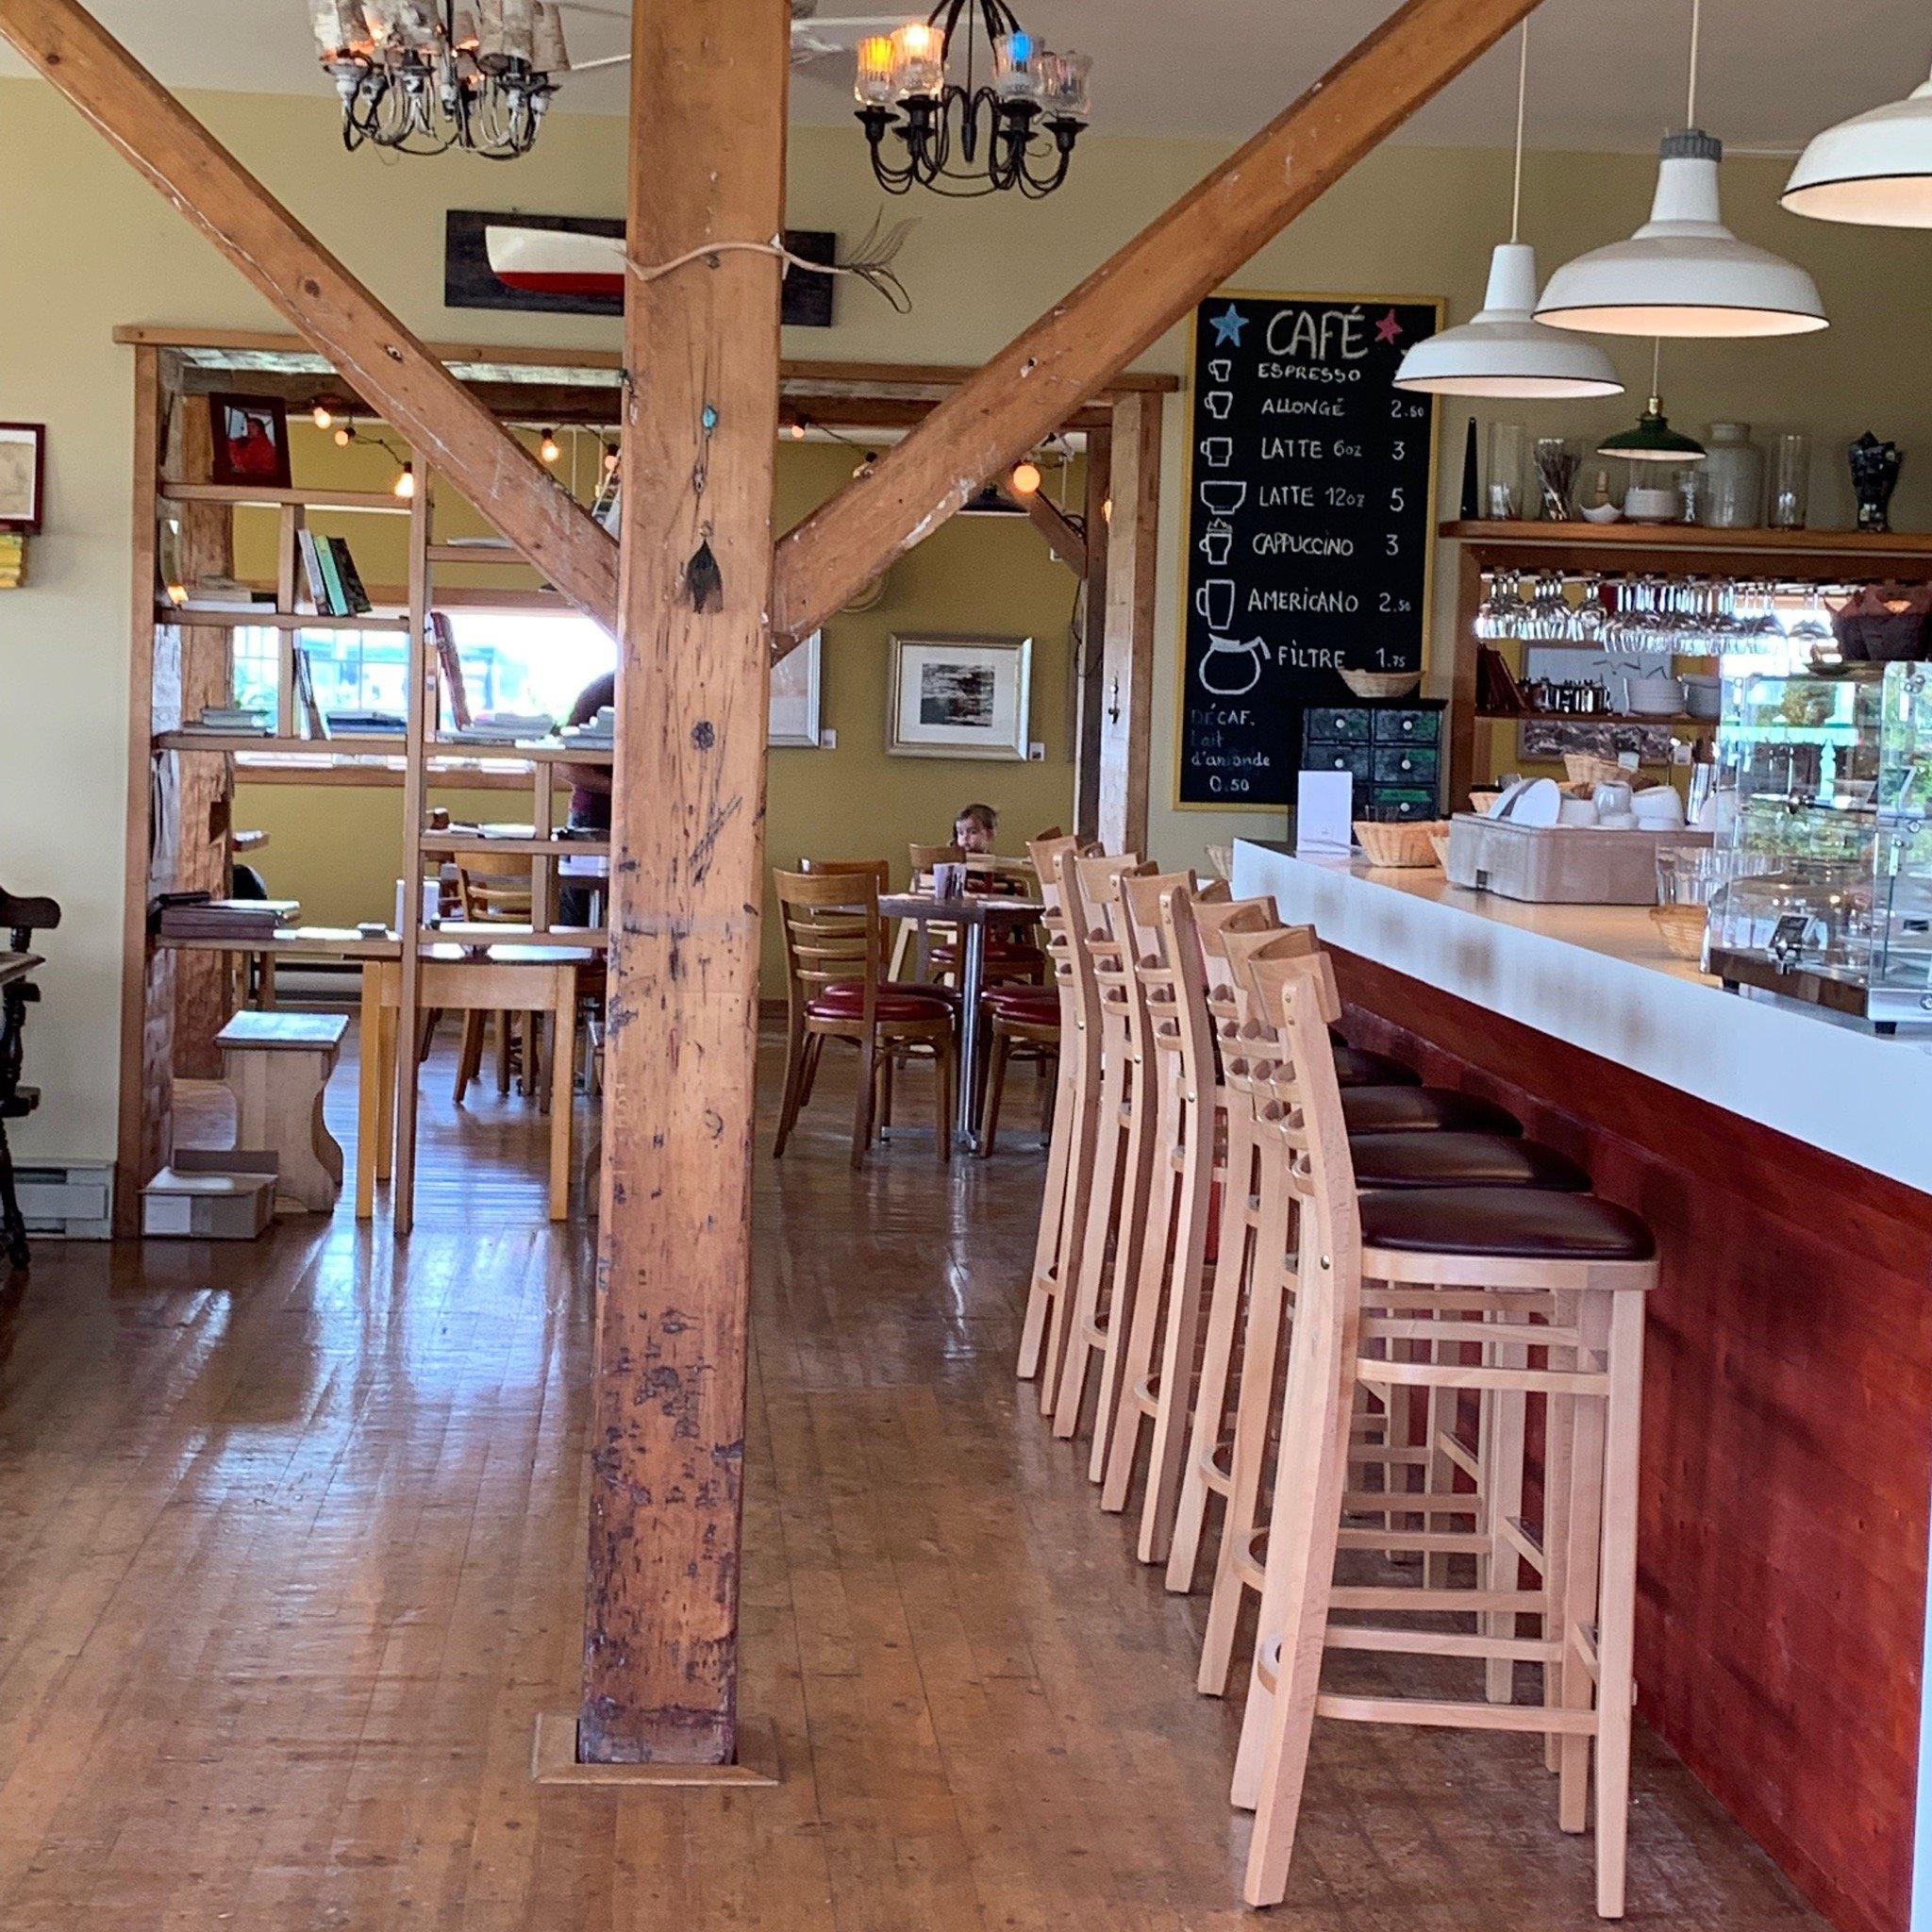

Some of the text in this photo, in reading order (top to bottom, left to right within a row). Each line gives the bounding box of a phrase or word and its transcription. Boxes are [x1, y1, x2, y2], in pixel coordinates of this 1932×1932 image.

[1266, 306, 1368, 360] CAFÉ
[1257, 362, 1361, 382] ESPRESSO
[1261, 398, 1345, 416] ALLONGÉ
[1261, 437, 1323, 459] LATTE
[1391, 441, 1406, 460] 3
[1259, 486, 1315, 507] LATTE
[1390, 487, 1405, 512] 5
[1386, 534, 1399, 556] 3
[1375, 648, 1406, 669] 1.75
